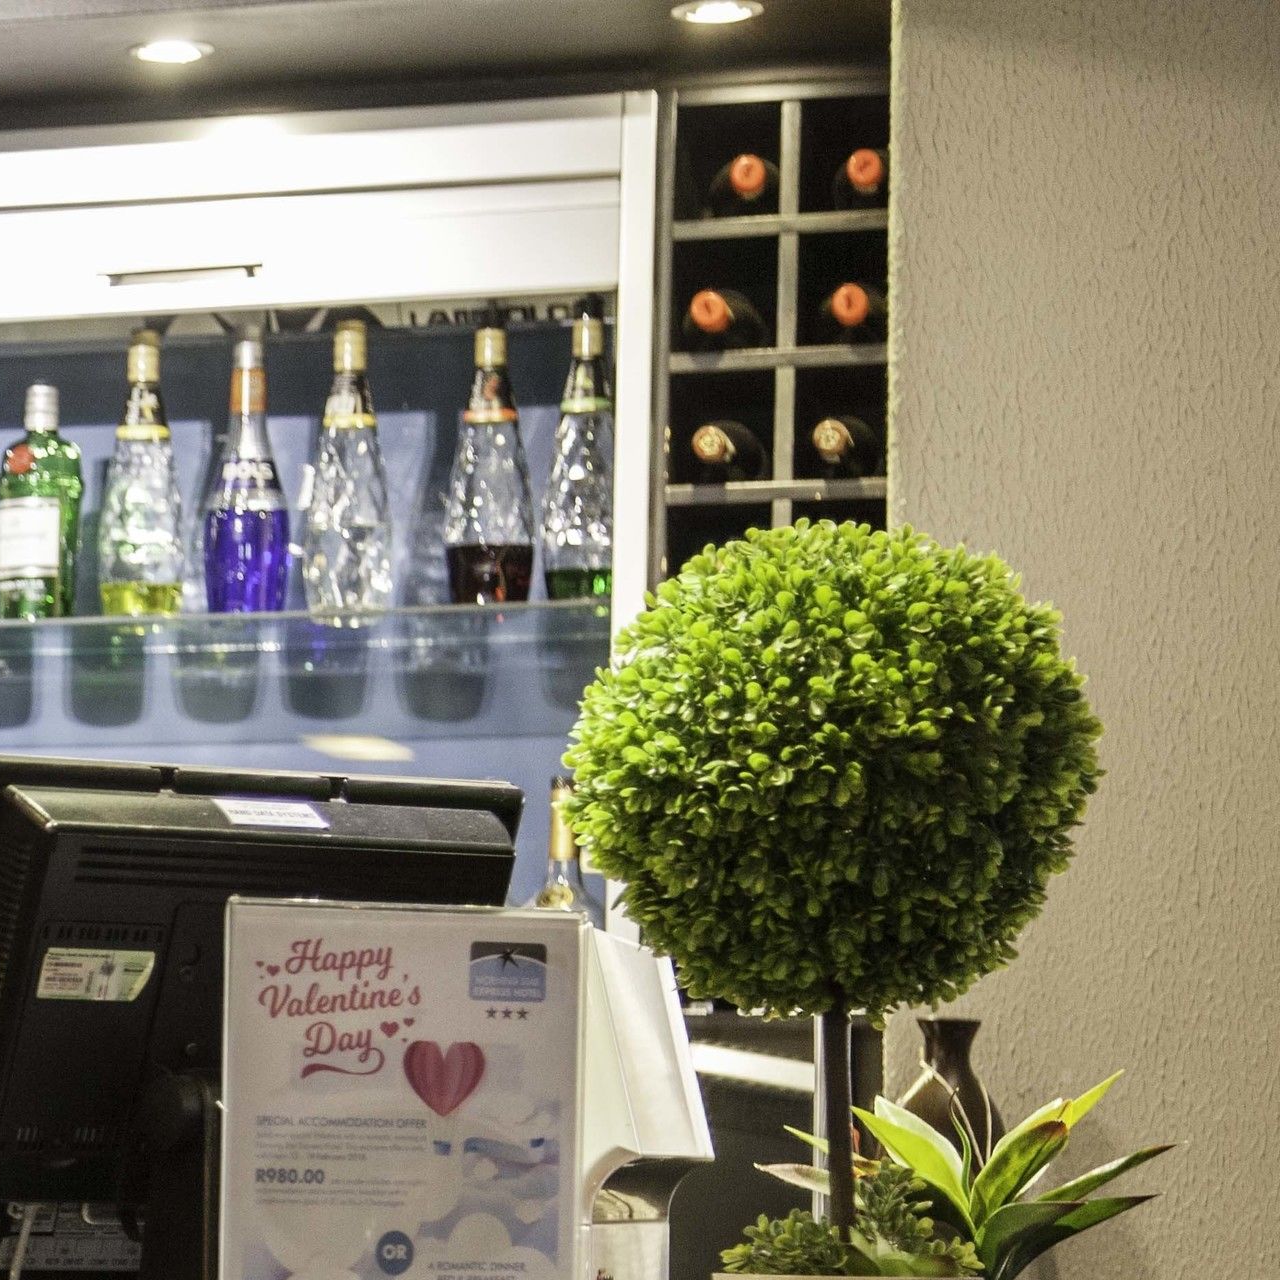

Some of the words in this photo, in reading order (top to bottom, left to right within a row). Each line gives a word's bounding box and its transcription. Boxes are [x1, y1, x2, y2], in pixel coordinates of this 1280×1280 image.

[285, 938, 393, 981] Happy
[258, 974, 421, 1018] Valentine's
[301, 1021, 386, 1079] Day
[256, 1115, 294, 1127] SPECIAL
[299, 1116, 394, 1128] ACCOMMODATION
[396, 1118, 428, 1129] OFFER
[255, 1168, 326, 1185] R980.00
[383, 1244, 408, 1260] OR
[437, 1261, 487, 1271] ROMANTIC
